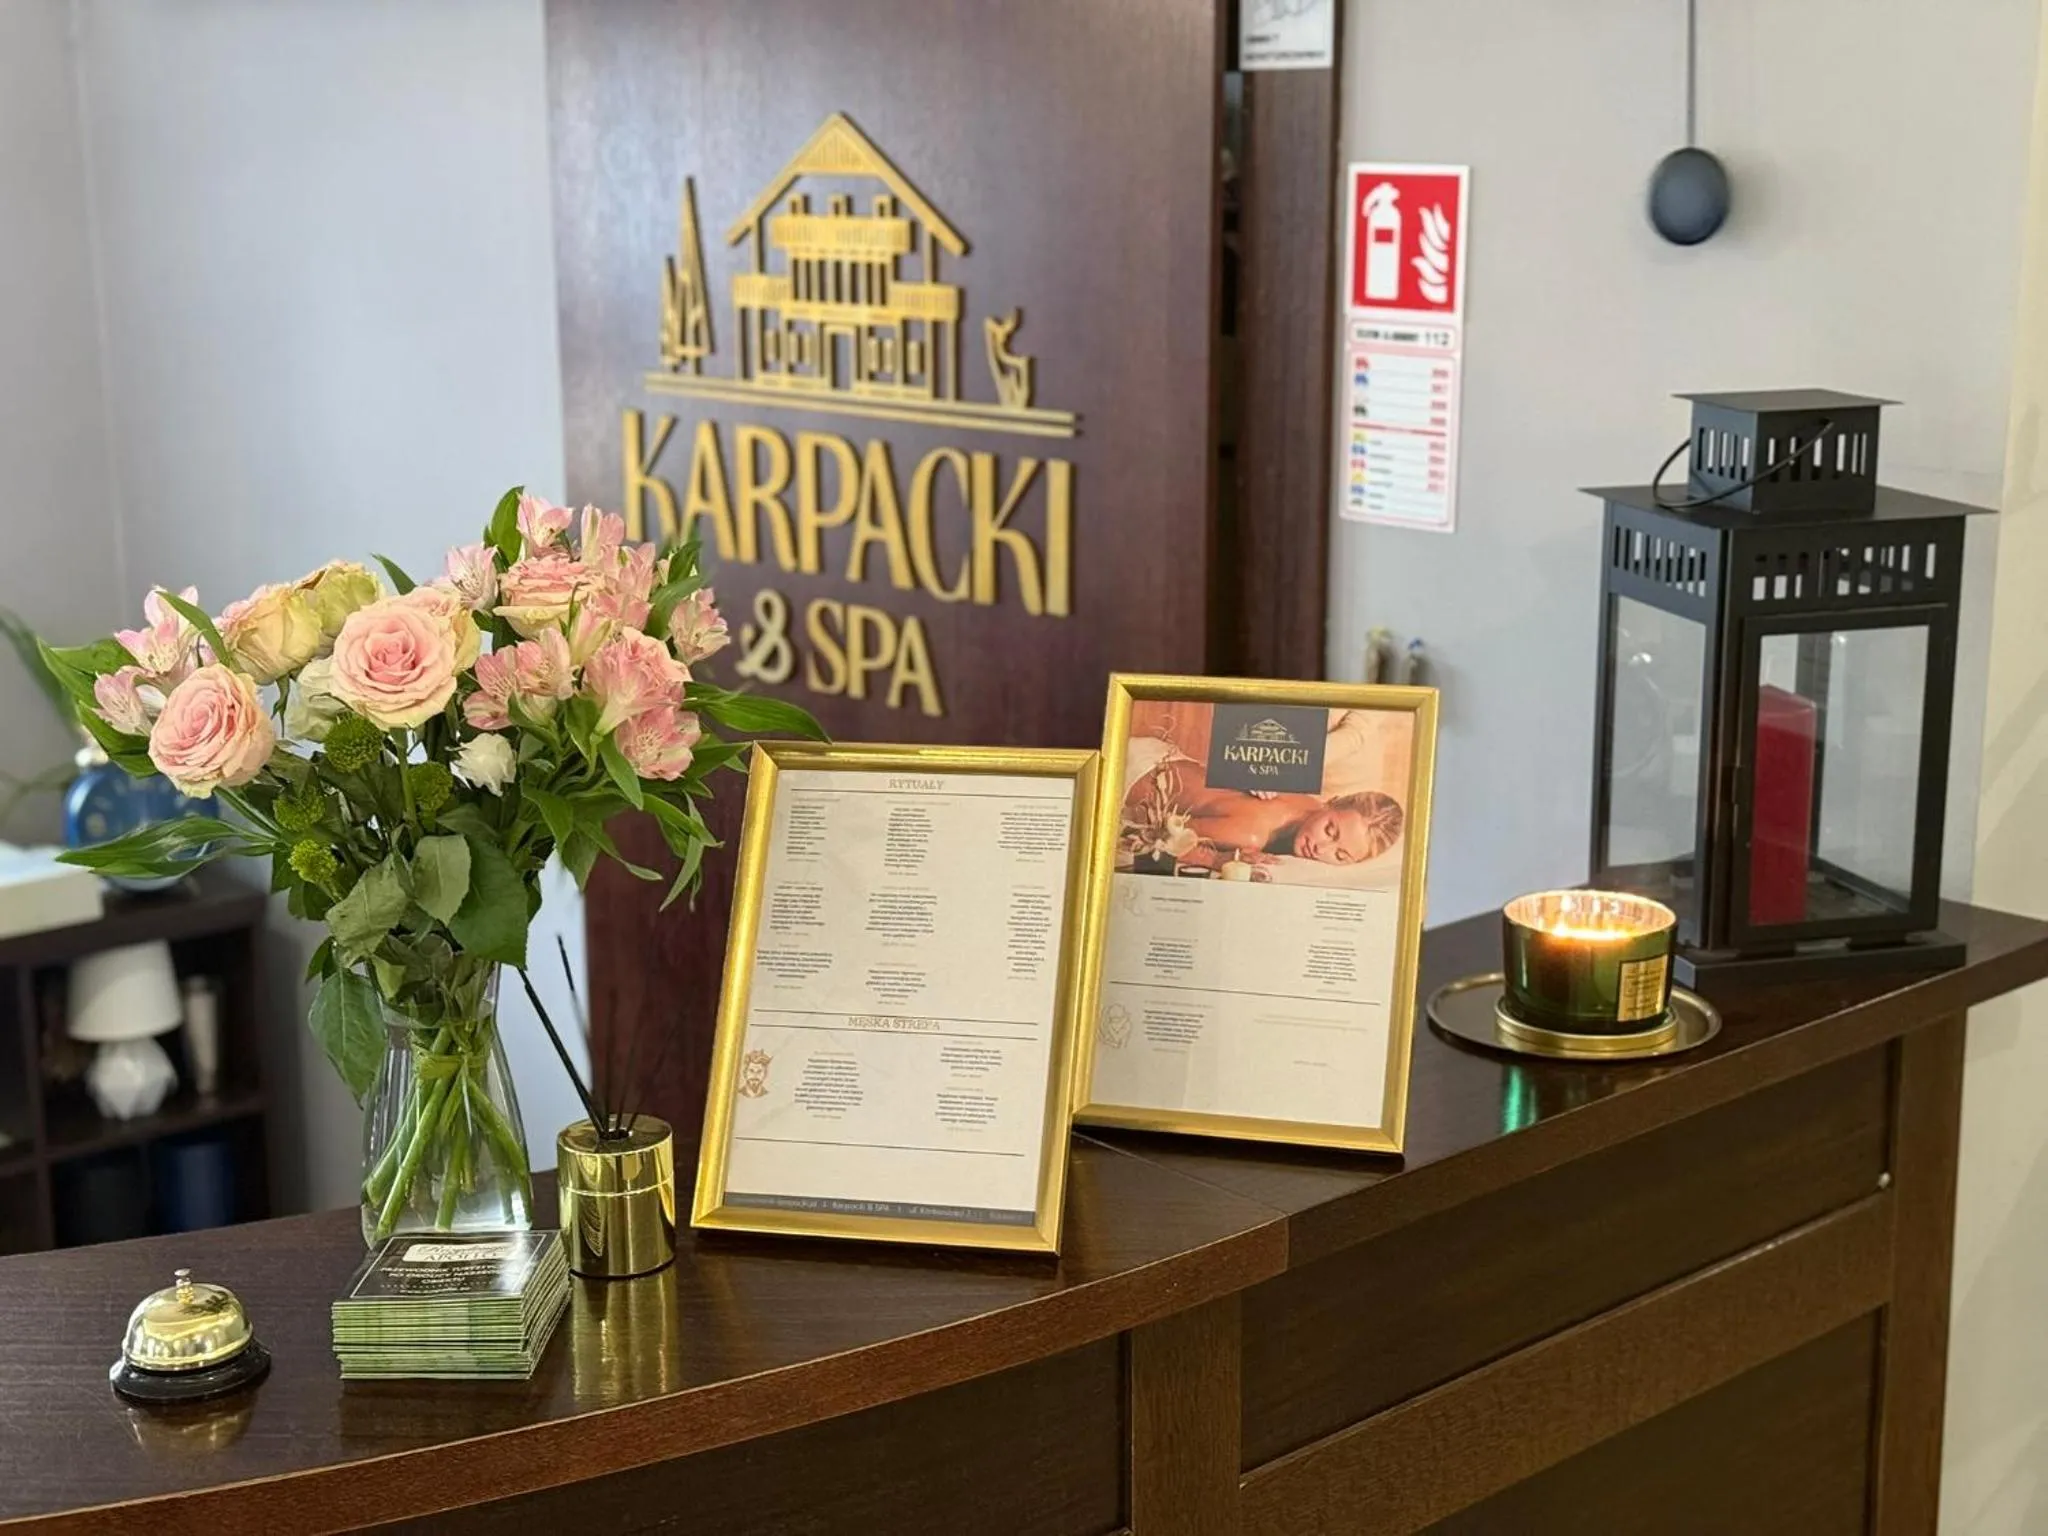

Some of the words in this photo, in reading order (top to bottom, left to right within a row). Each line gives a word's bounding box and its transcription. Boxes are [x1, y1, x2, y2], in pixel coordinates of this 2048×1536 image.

[622, 408, 1073, 617] KARPACKI
[735, 588, 792, 684] &
[806, 597, 943, 716] SPA
[1224, 744, 1309, 766] KARPACKI
[1259, 764, 1279, 776] SPA
